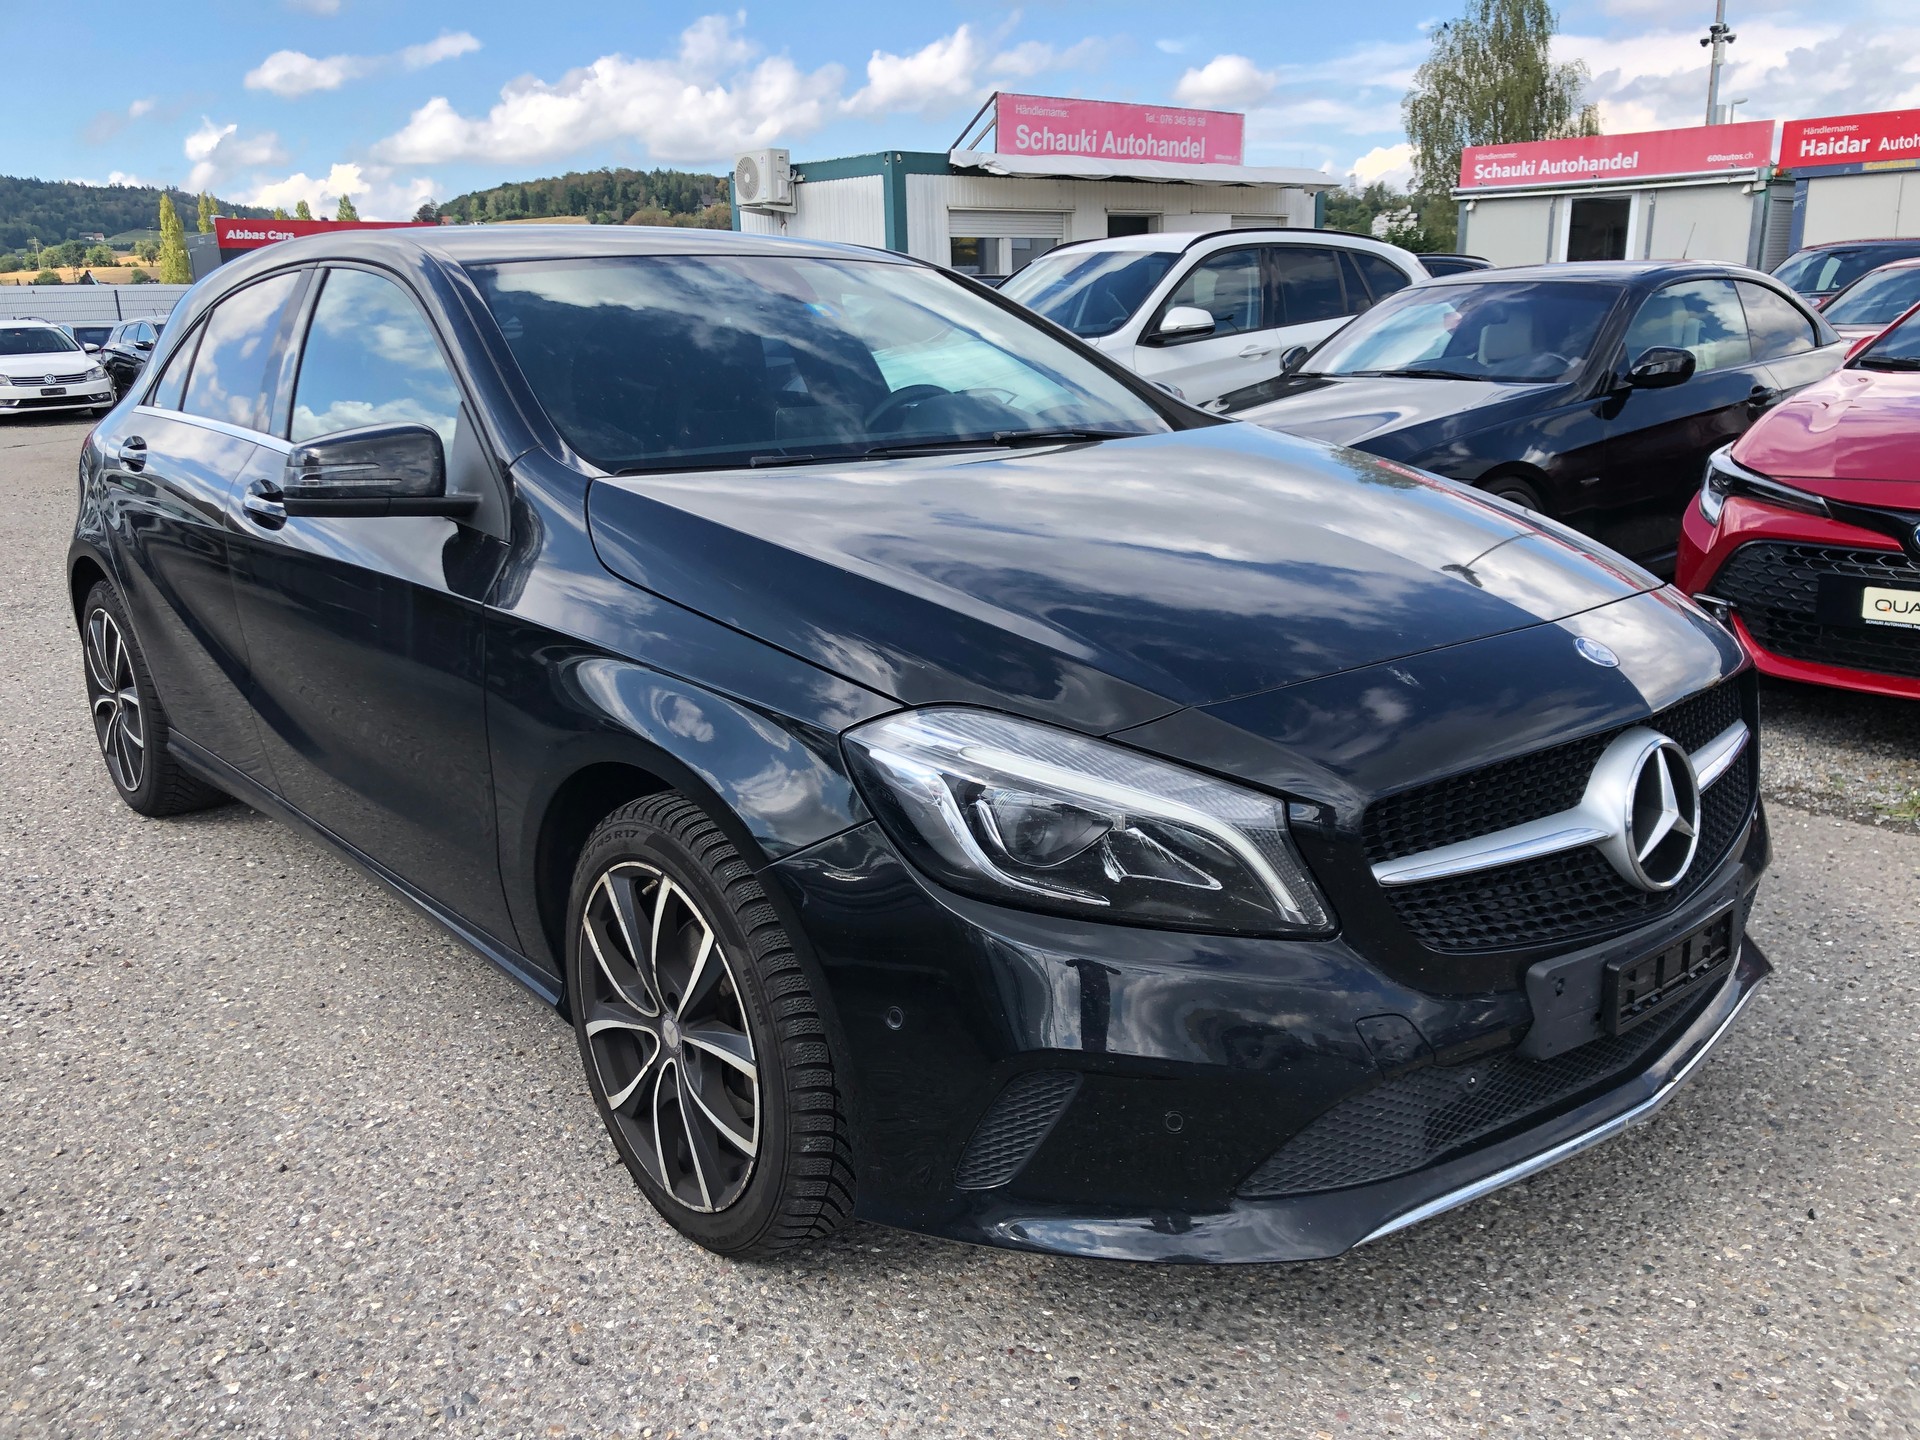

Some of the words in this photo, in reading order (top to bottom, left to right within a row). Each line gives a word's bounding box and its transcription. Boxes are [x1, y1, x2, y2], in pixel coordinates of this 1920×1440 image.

[1015, 104, 1070, 118] Händlername:
[1160, 115, 1173, 125] 076
[1174, 116, 1187, 126] 345
[1803, 124, 1859, 136] Händlername:
[1015, 124, 1097, 153] Schauki
[1101, 131, 1206, 159] Autohandel
[1800, 136, 1871, 157] Haidar
[1706, 151, 1754, 163] 600autos.ch
[1474, 160, 1536, 180] Schauki
[1538, 151, 1639, 175] Autohandel
[226, 229, 266, 240] Abbas
[267, 230, 295, 240] Cars
